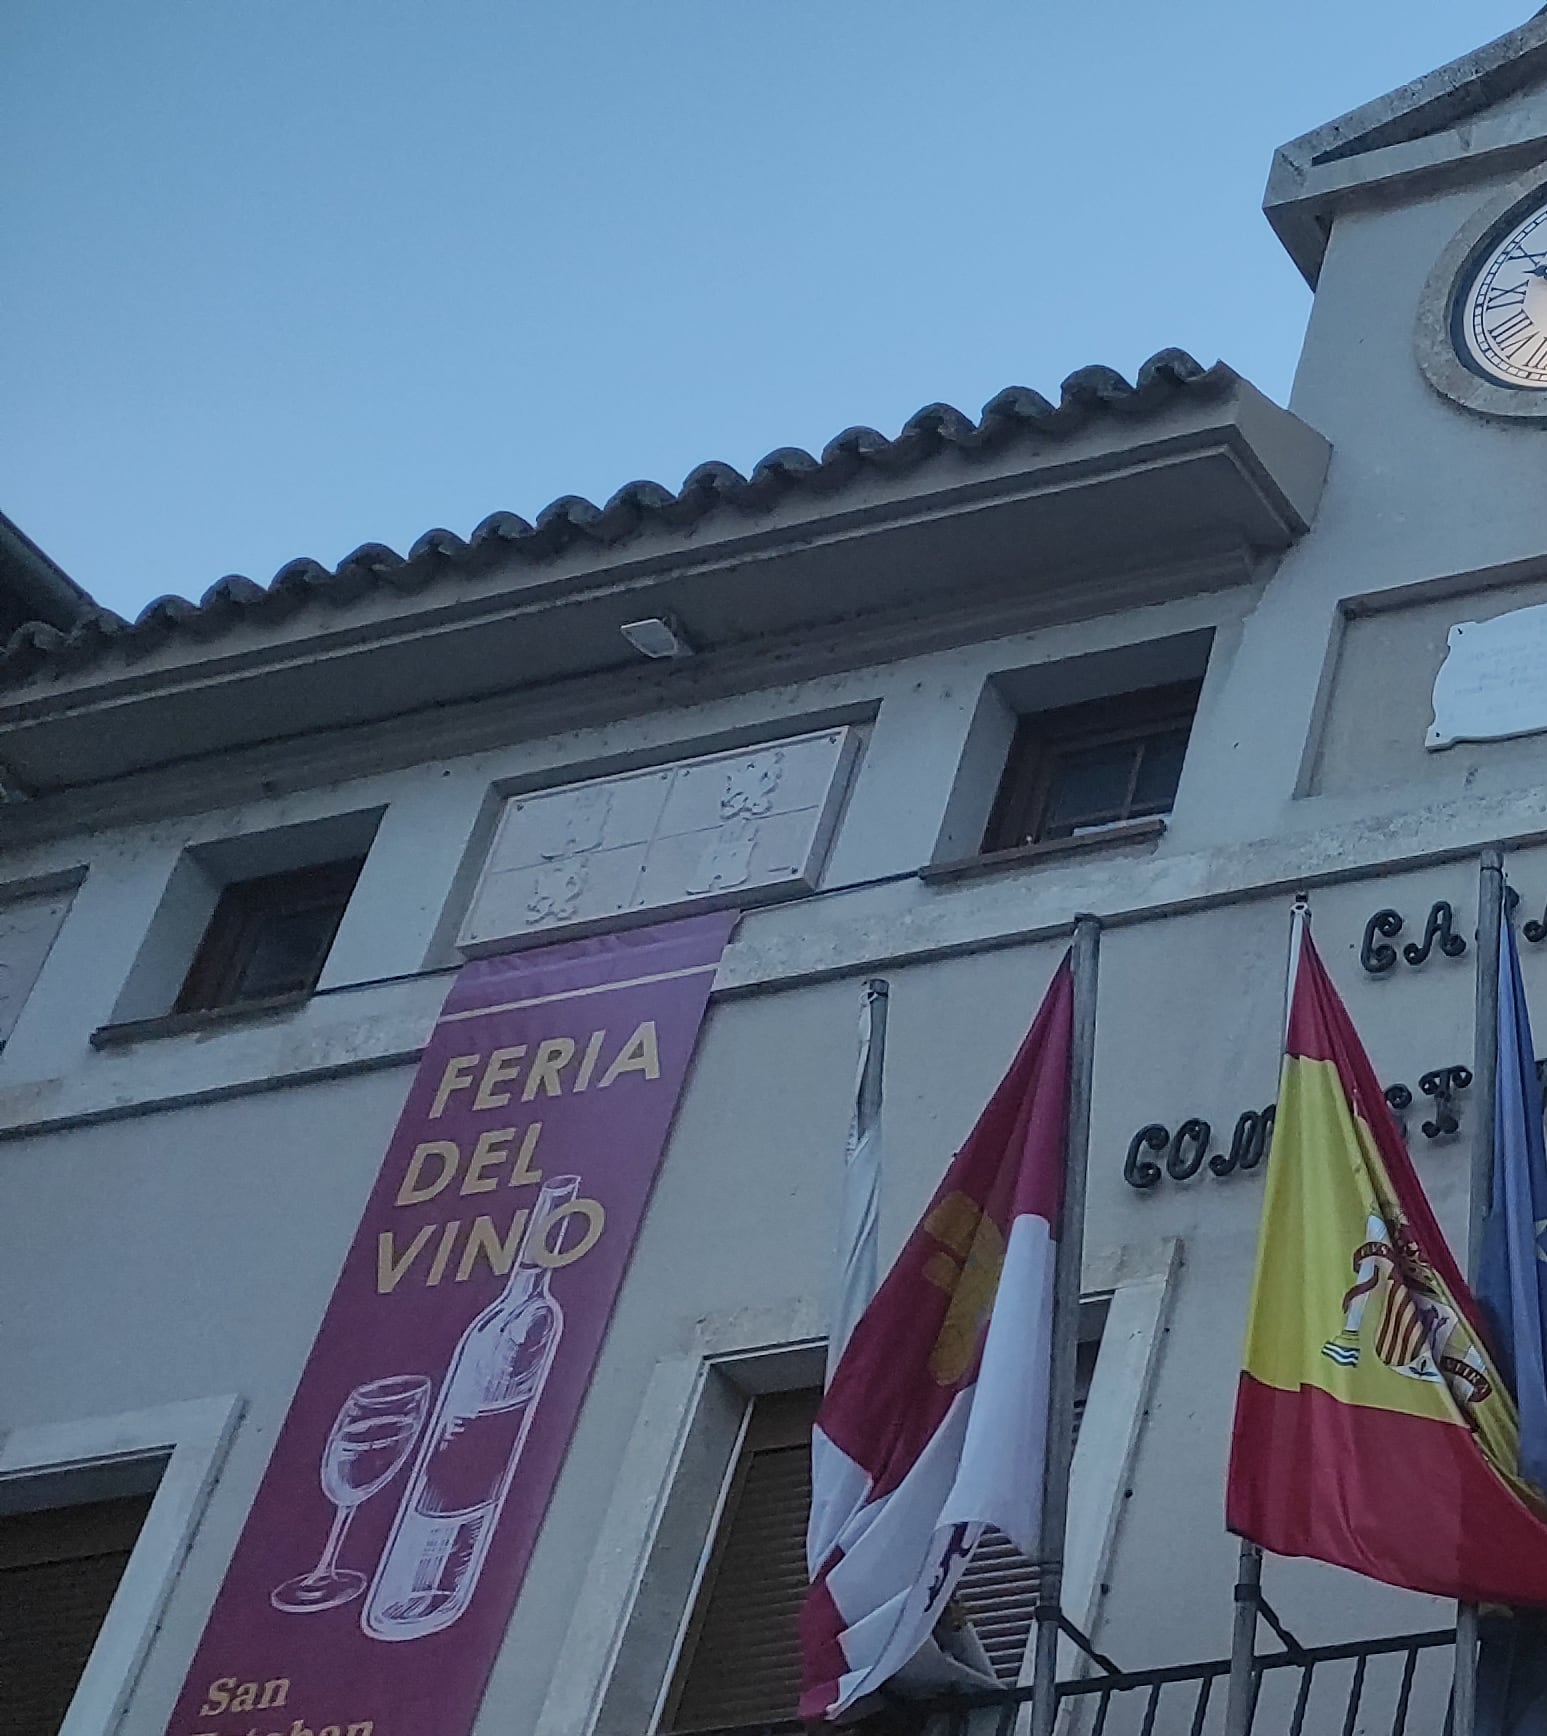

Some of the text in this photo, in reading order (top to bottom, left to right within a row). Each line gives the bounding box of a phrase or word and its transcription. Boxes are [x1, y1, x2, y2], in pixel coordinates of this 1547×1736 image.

[1487, 280, 1530, 310] IX
[1487, 308, 1540, 359] VIII
[428, 1021, 661, 1120] FERIA
[394, 1122, 544, 1207] DEL
[377, 1198, 605, 1294] VINO
[199, 1677, 292, 1718] San
